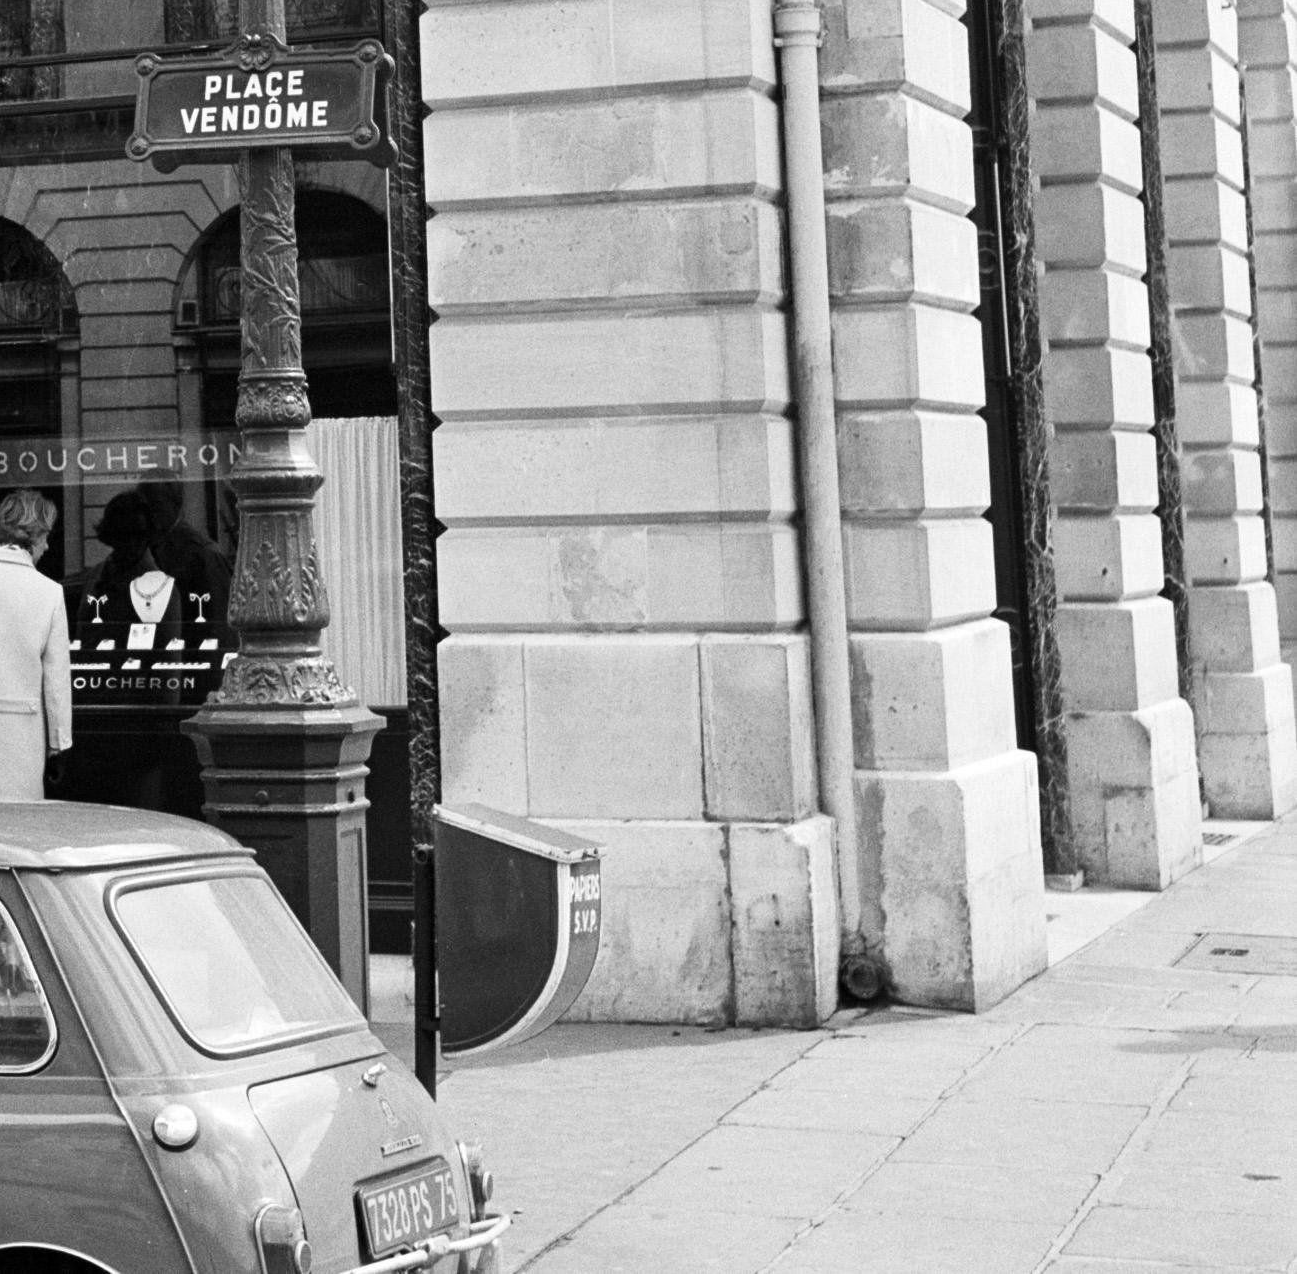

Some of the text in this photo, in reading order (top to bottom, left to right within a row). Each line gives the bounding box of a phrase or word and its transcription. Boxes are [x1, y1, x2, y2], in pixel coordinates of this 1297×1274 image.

[204, 70, 304, 101] PLACE
[180, 97, 329, 134] VENDÔME
[435, 1171, 458, 1220] 75
